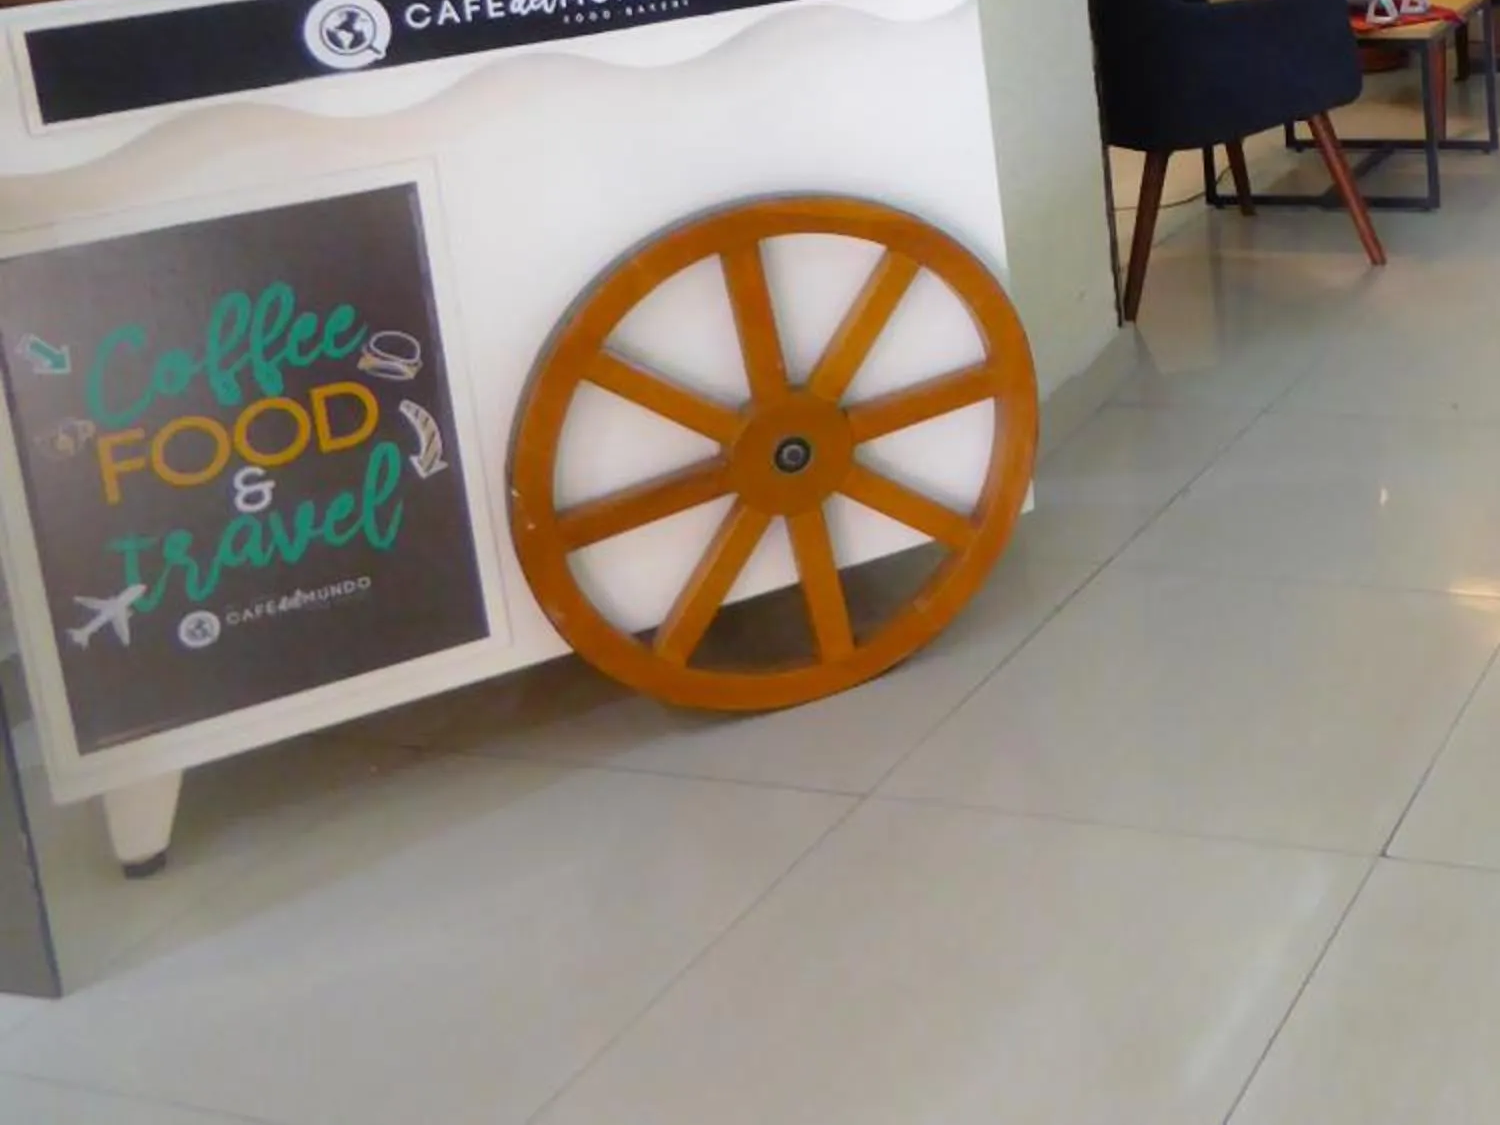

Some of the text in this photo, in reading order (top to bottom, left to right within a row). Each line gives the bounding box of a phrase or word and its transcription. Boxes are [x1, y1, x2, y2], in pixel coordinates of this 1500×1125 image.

[87, 280, 369, 432] Coffee
[98, 382, 380, 506] FOOD
[232, 466, 276, 513] &
[302, 576, 371, 604] MUNDO
